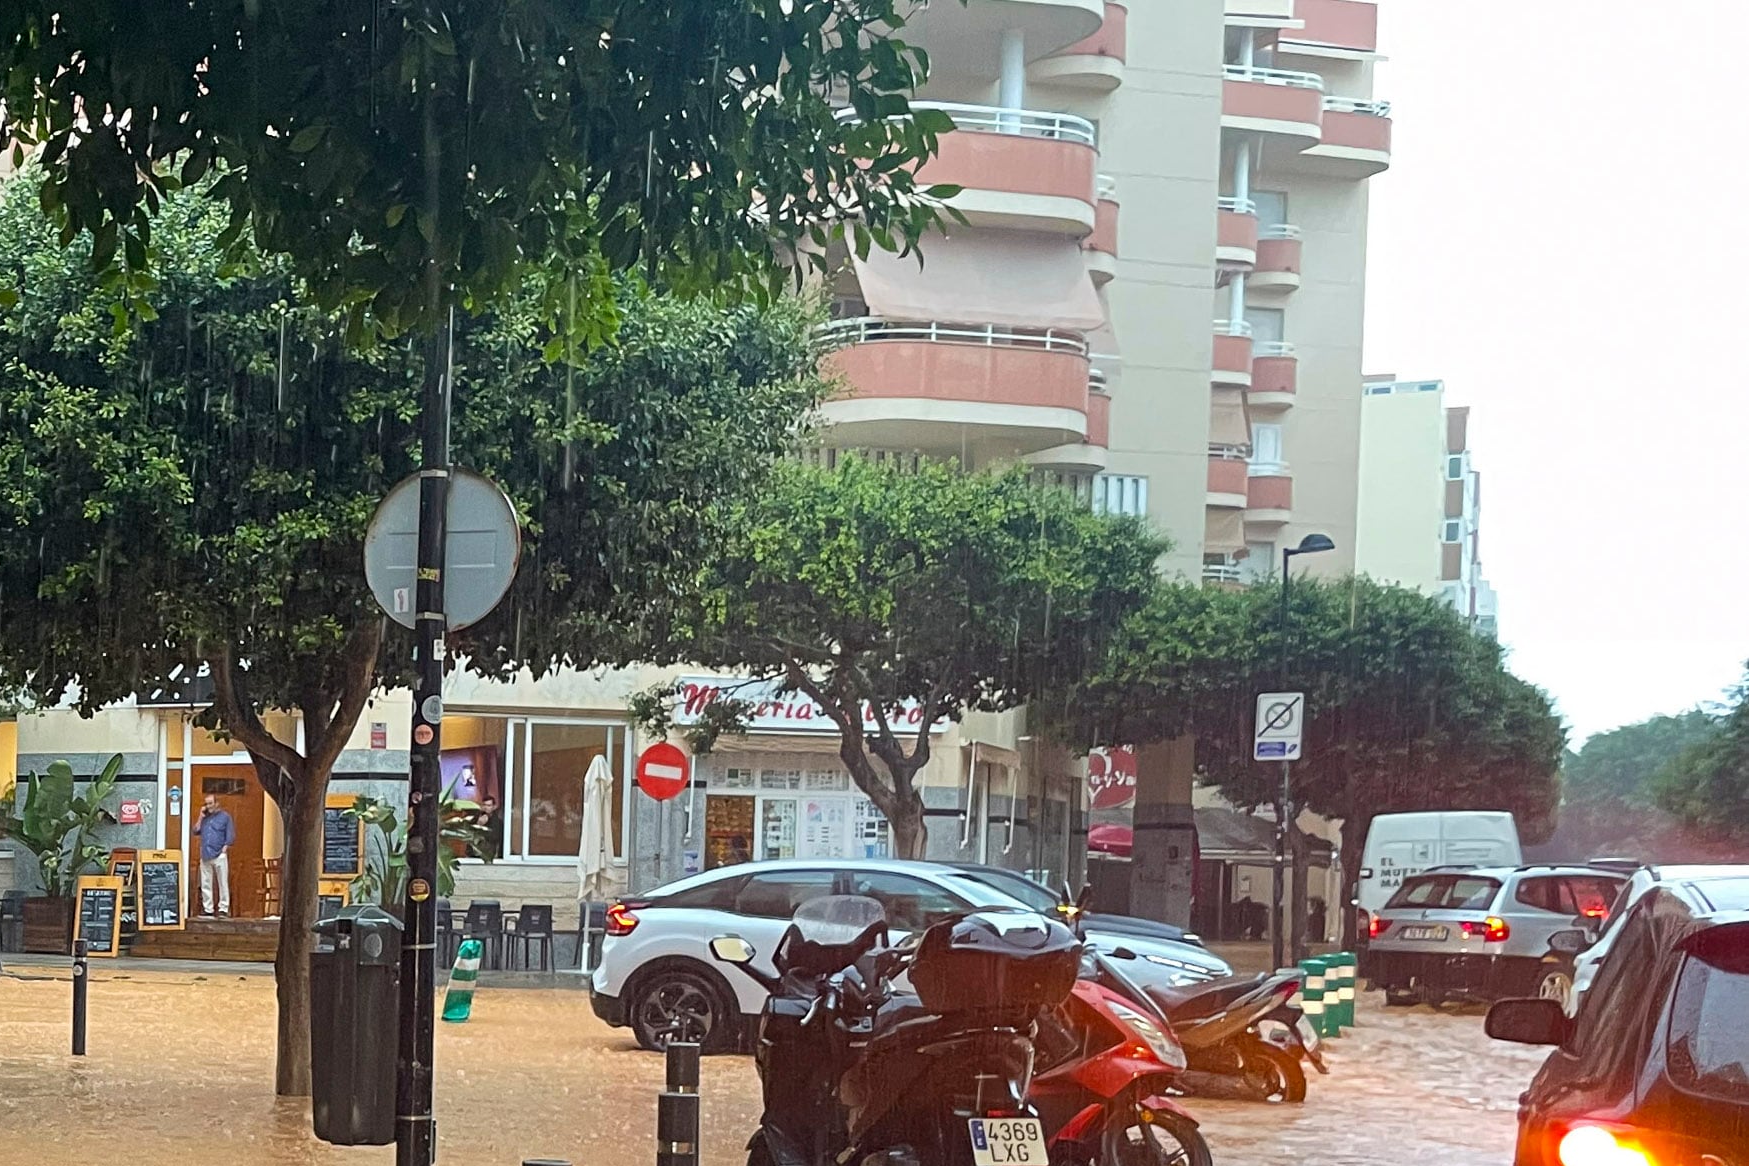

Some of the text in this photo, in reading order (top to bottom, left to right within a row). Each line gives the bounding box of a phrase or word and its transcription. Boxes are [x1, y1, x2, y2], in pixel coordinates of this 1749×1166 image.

[682, 682, 813, 720] Meria
[988, 1122, 1038, 1141] 4369
[990, 1143, 1030, 1162] LXG
